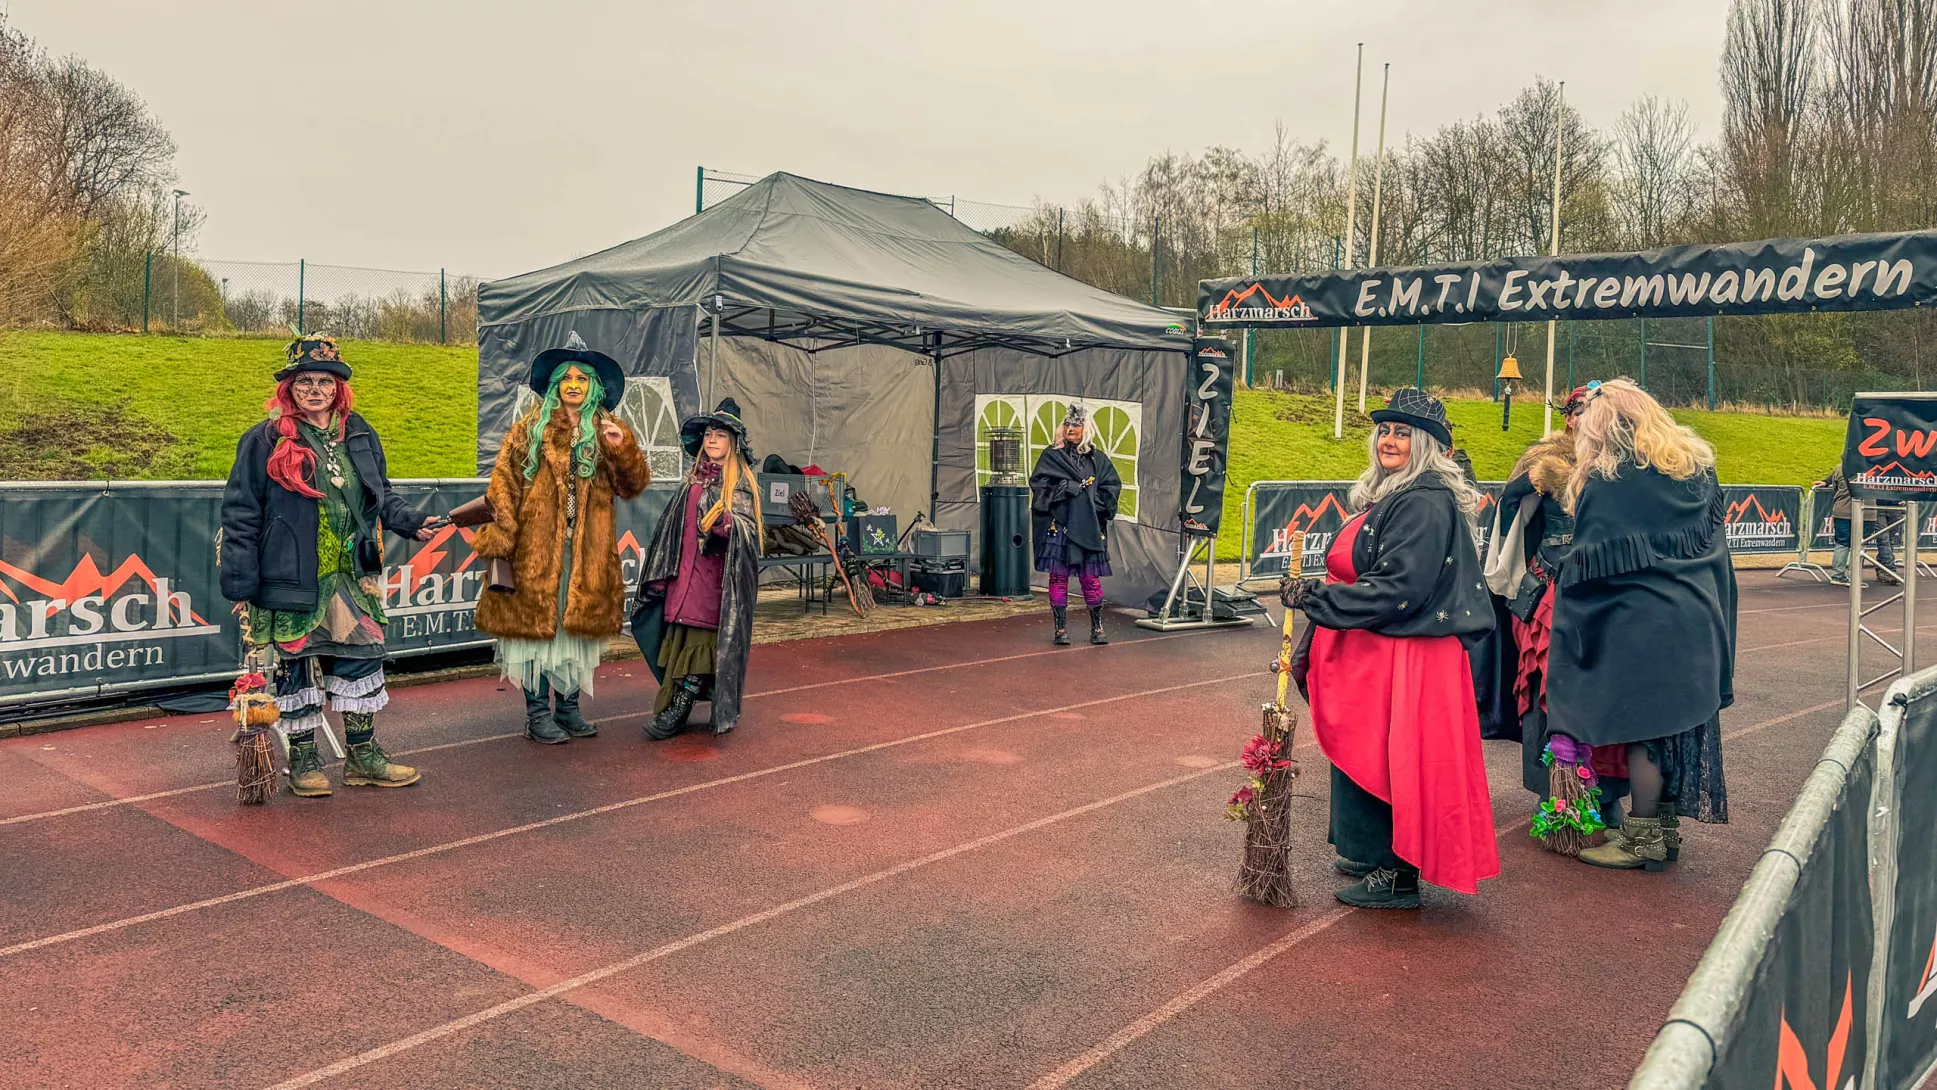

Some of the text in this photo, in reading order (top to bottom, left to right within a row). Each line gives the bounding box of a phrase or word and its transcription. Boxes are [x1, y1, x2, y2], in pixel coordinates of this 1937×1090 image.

[1354, 247, 1913, 317] E.M.T.I Extremwandern
[1209, 302, 1310, 319] Harzmarsch
[3, 643, 164, 679] wandern
